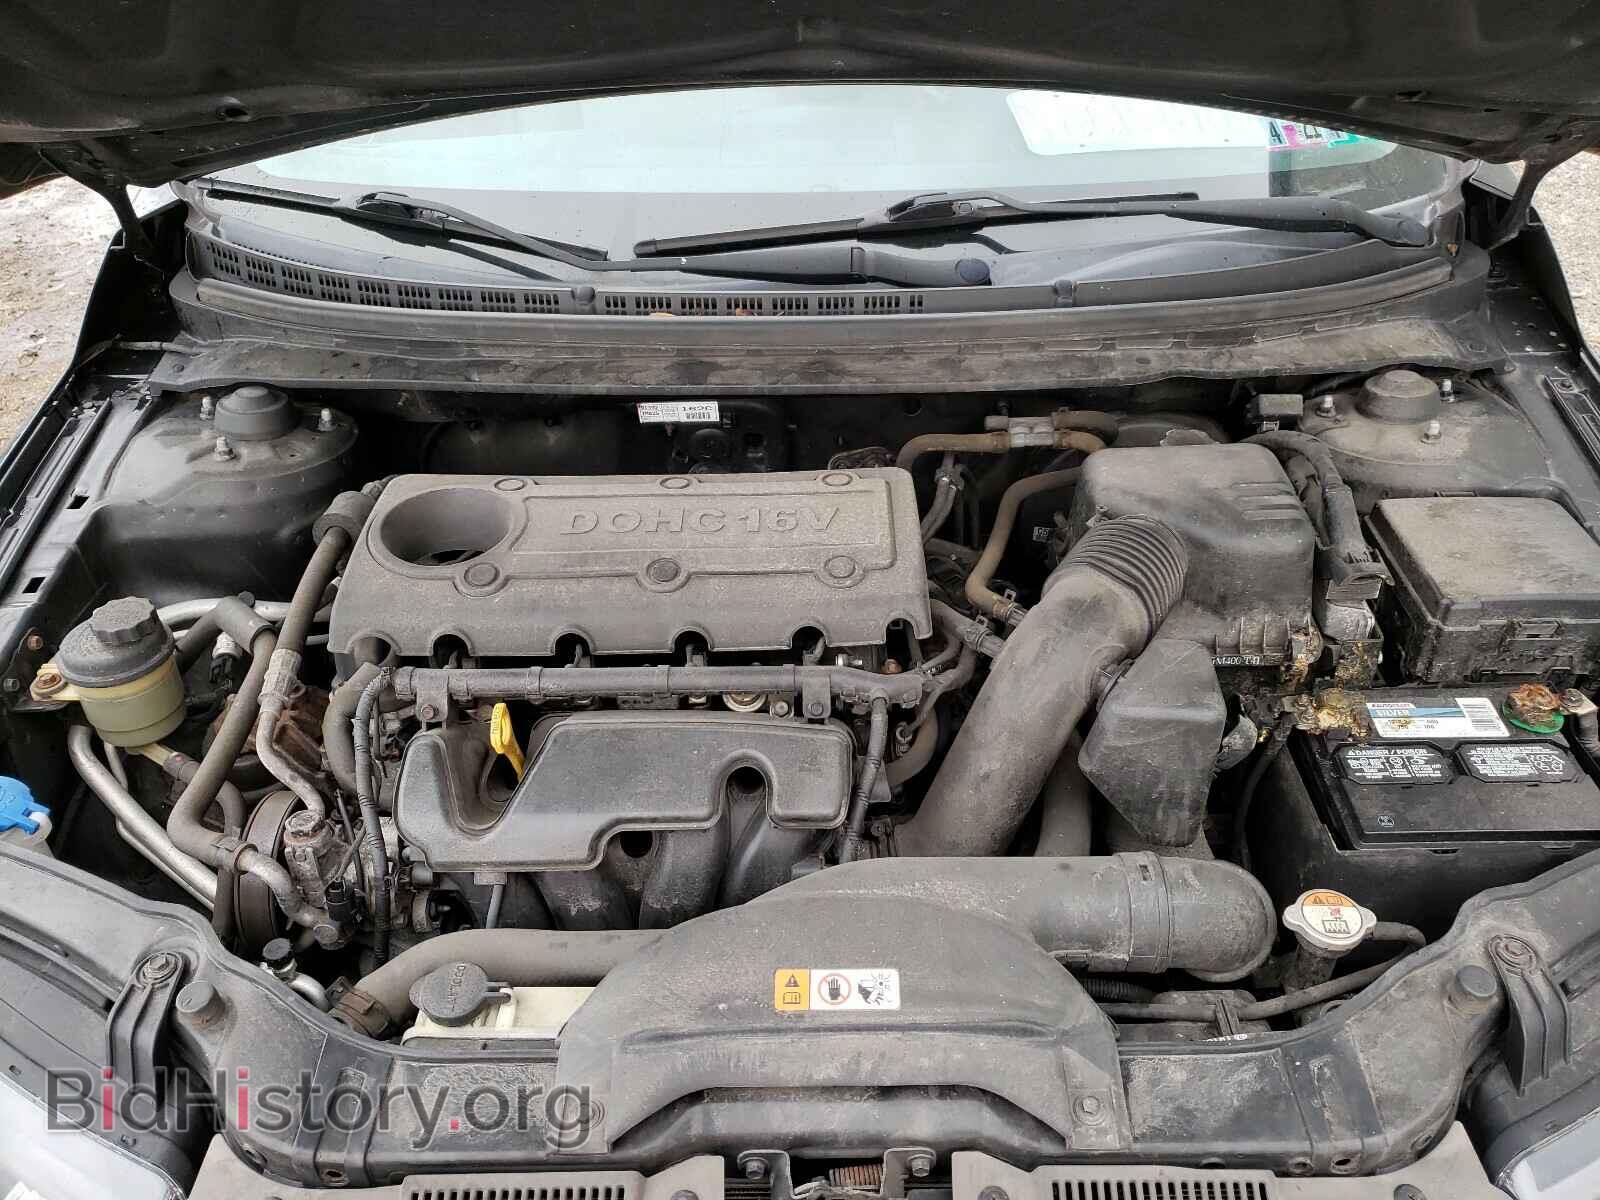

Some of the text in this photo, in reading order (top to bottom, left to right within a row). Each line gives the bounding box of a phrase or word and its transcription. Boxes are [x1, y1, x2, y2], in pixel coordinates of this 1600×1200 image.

[560, 506, 840, 534] DOHC 16V
[1375, 709, 1409, 717] SILVER
